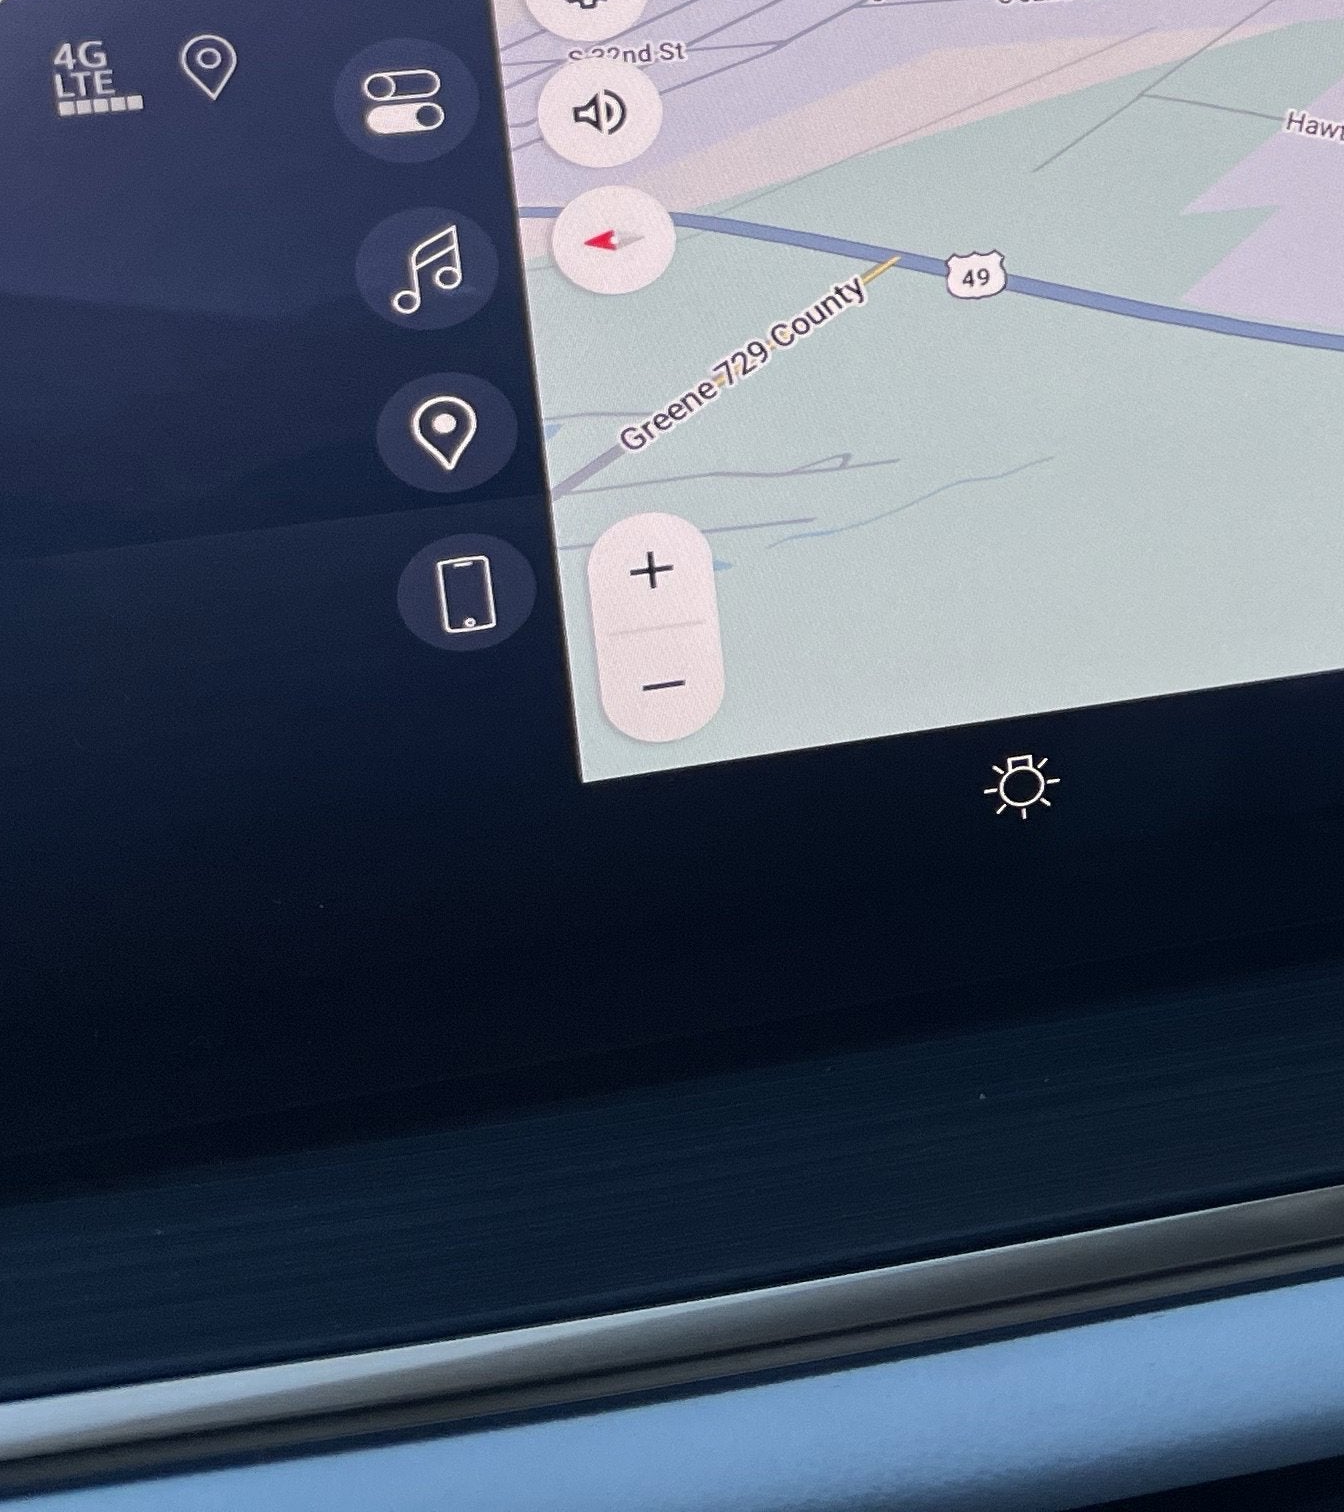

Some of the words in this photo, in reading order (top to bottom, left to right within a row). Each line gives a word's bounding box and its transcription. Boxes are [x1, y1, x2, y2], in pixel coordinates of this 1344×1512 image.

[53, 41, 108, 70] 4G
[660, 43, 684, 61] St
[54, 70, 115, 99] LTE
[962, 268, 990, 288] 49
[619, 379, 718, 451] Greene
[713, 341, 770, 387] 729
[770, 277, 865, 347] County
